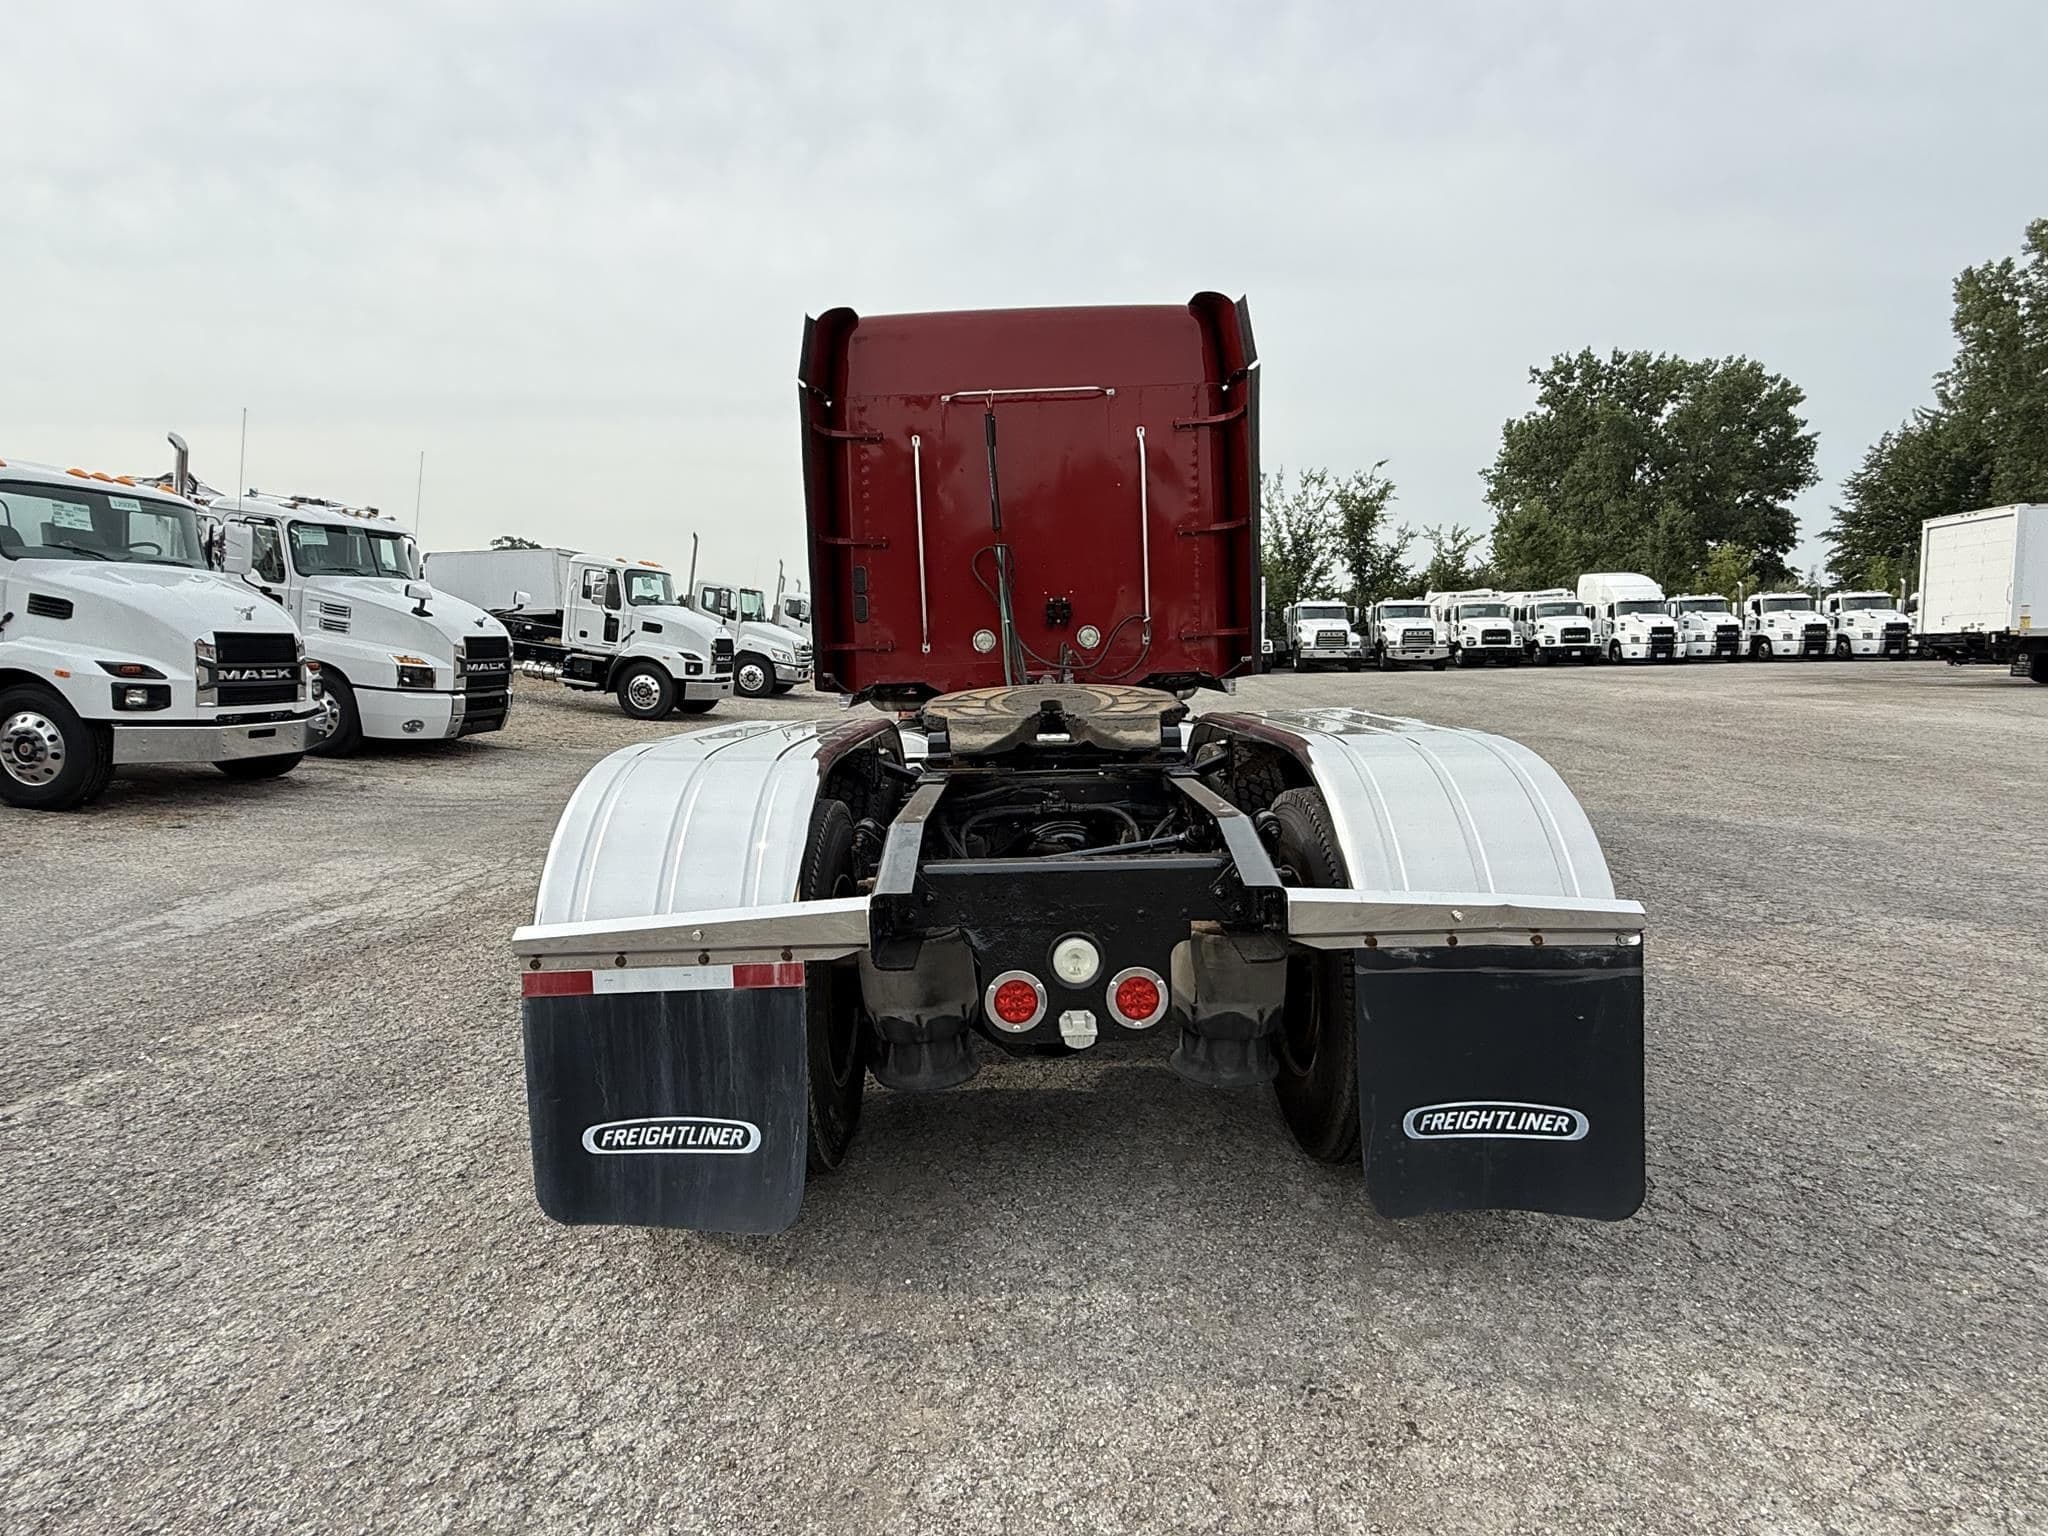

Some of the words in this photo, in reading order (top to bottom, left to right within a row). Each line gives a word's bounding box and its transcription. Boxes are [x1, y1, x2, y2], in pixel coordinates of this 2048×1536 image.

[217, 668, 292, 680] MACK
[466, 662, 506, 671] MACK
[1419, 1110, 1570, 1132] FREIGHTLINER
[601, 1126, 744, 1147] FREIGHTLINER
